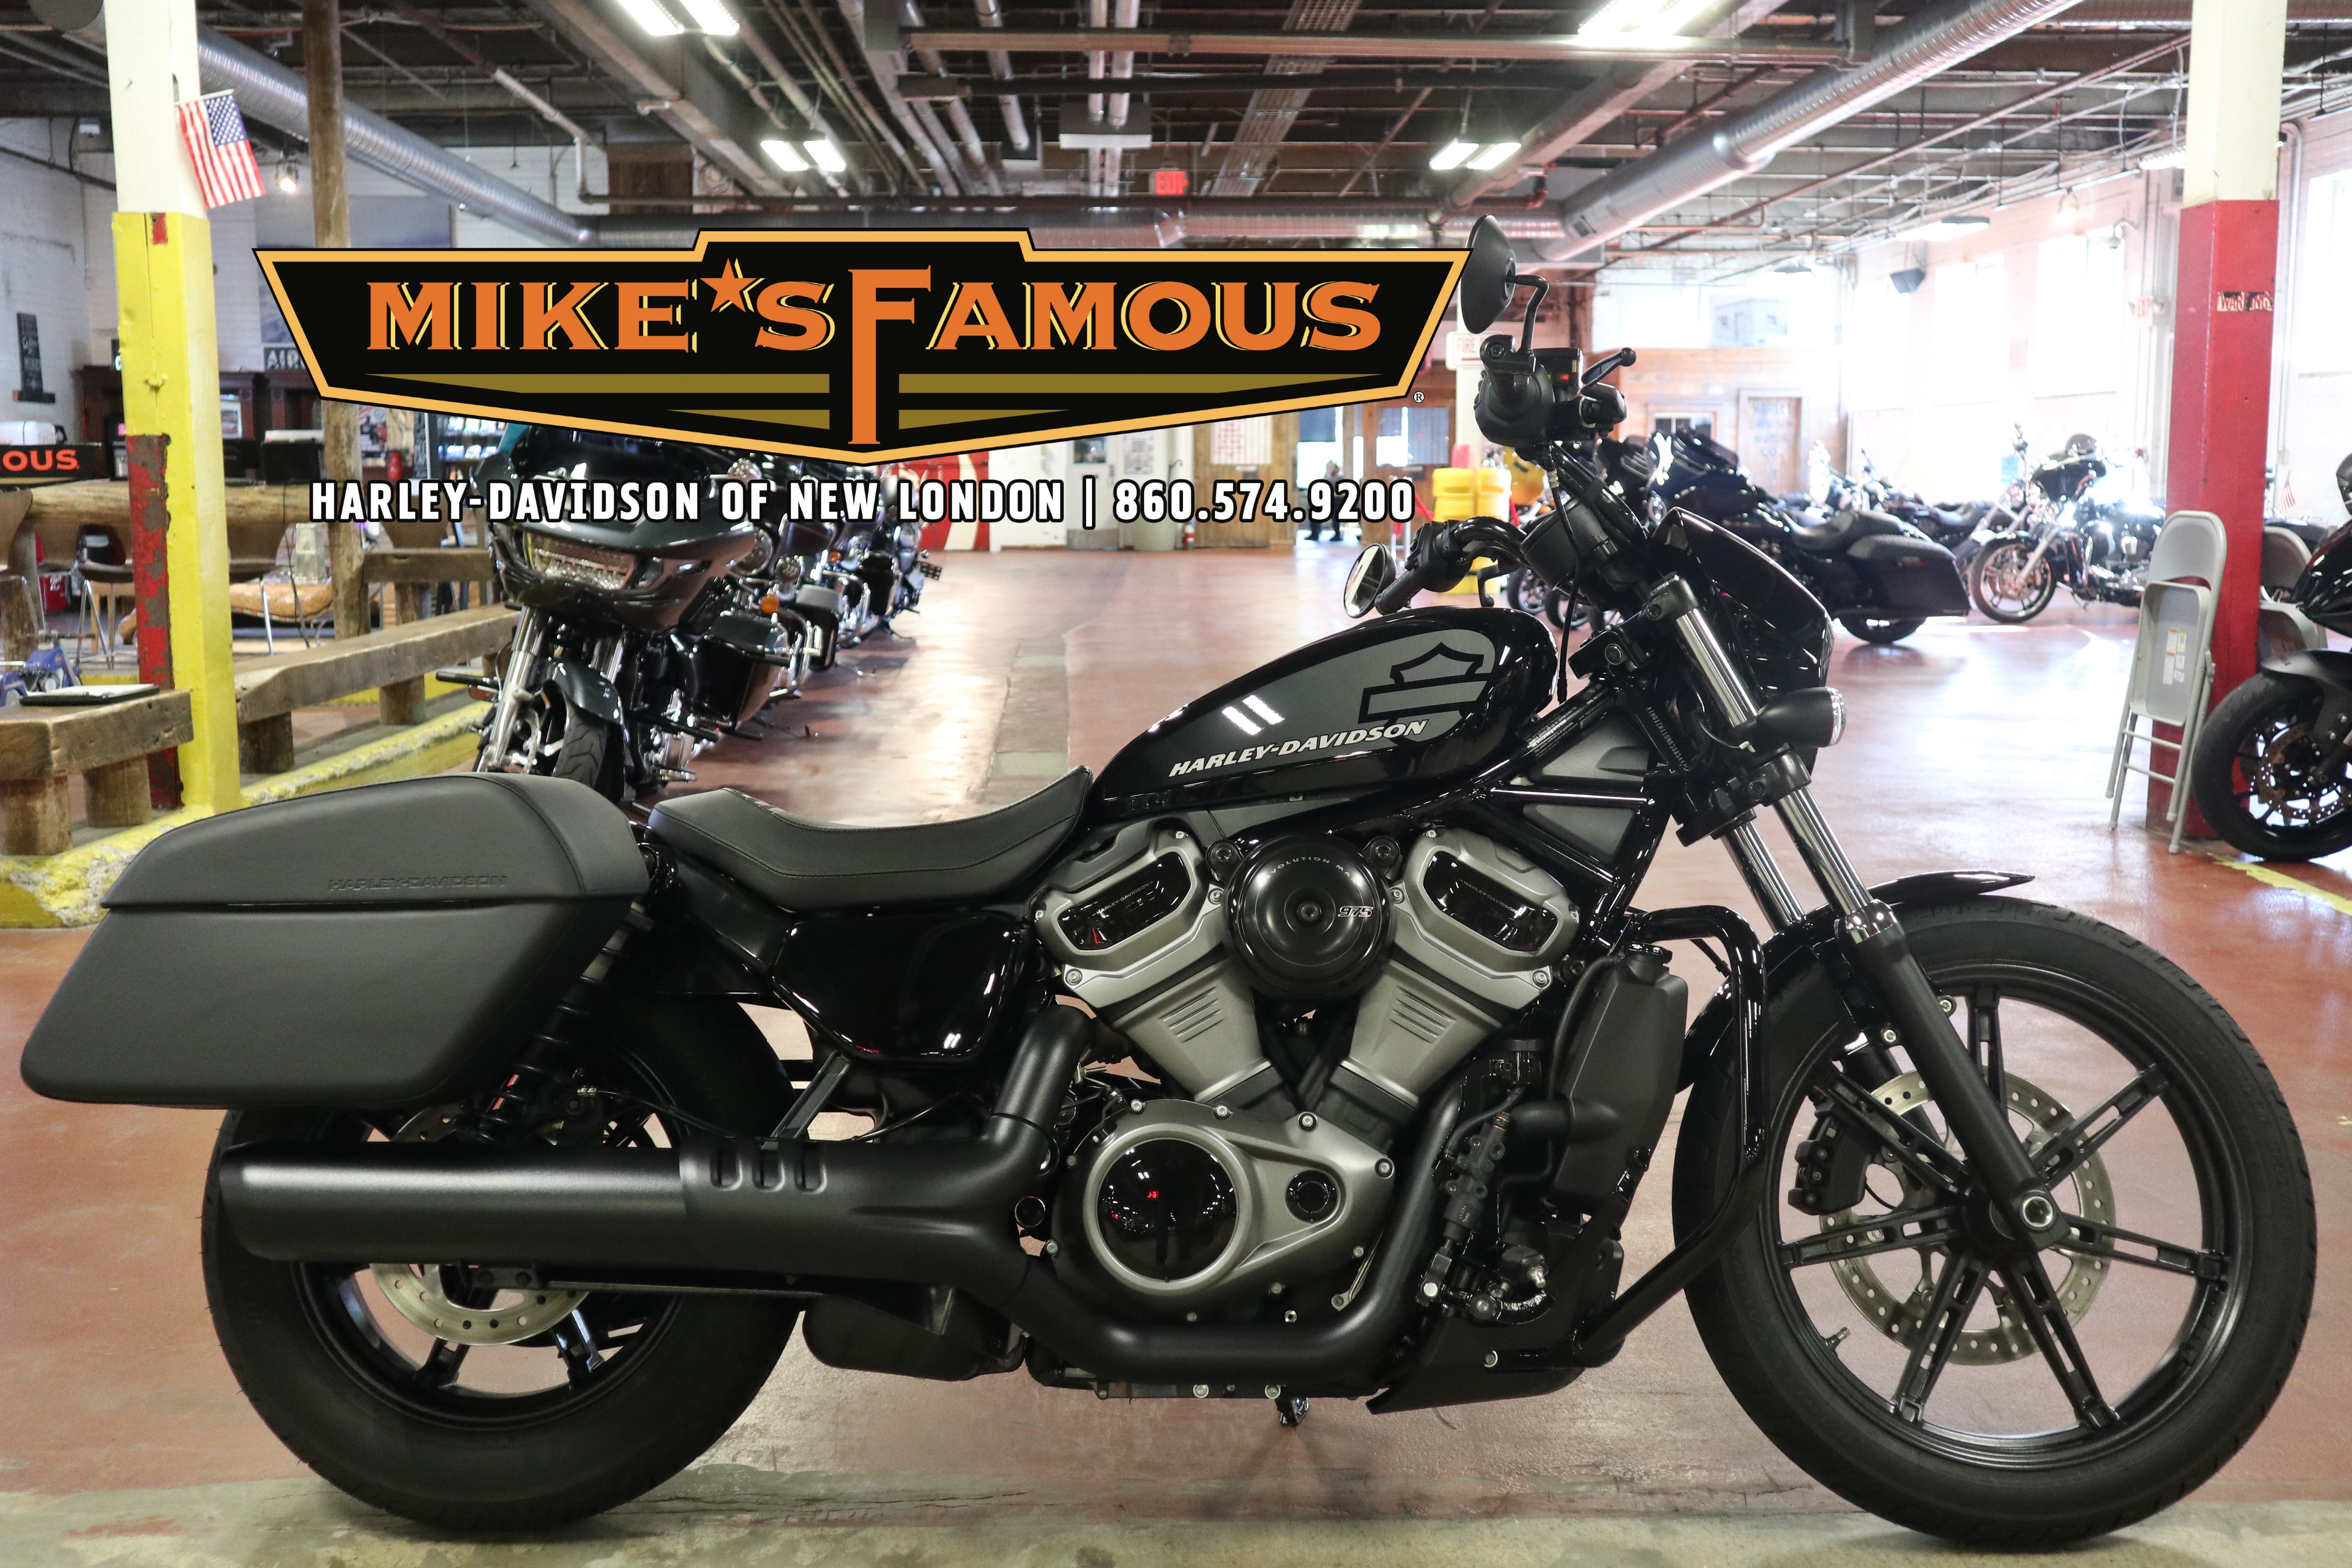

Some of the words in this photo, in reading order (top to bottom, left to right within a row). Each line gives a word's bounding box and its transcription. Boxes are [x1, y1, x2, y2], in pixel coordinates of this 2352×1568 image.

[1156, 171, 1185, 194] EXIT
[267, 349, 306, 370] AIR
[0, 449, 78, 471] OUS
[1168, 719, 1429, 777] HARLEY-DAVIDSON
[328, 875, 508, 891] HARLEY-DAVIDSON
[1338, 906, 1374, 917] 975
